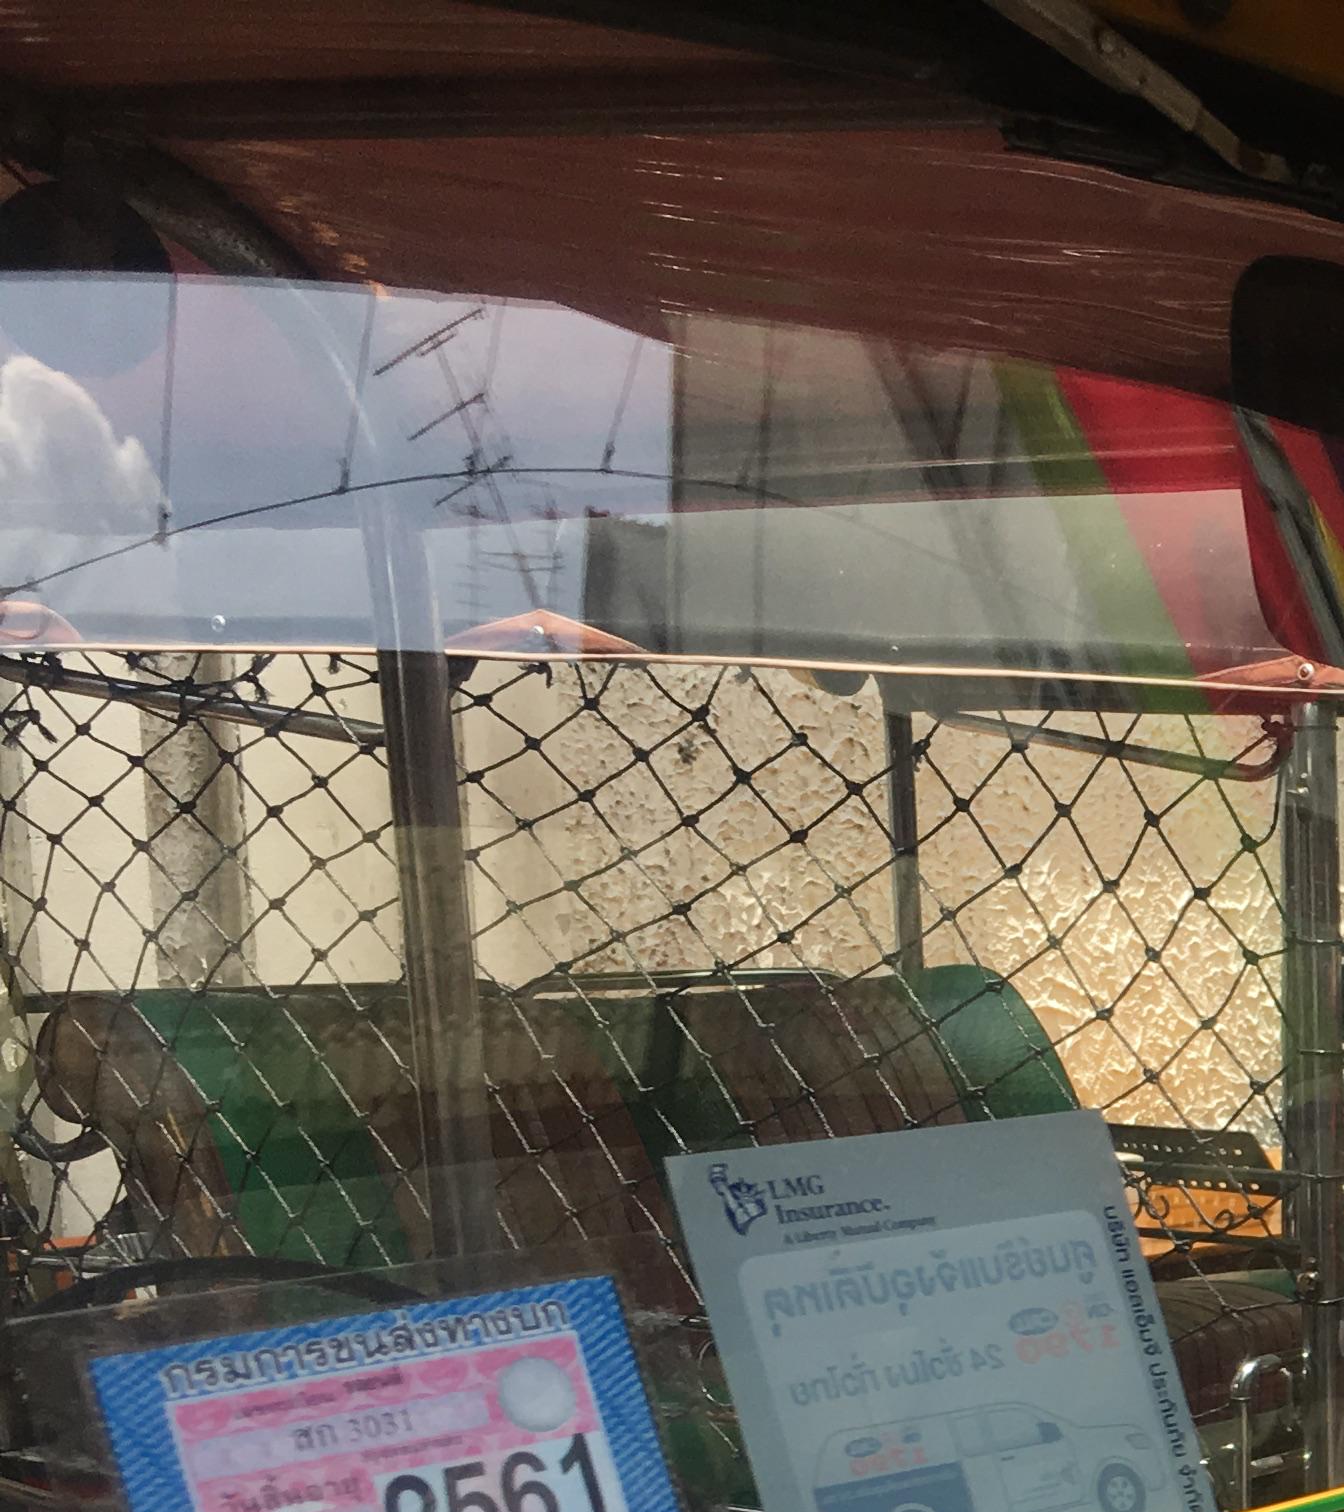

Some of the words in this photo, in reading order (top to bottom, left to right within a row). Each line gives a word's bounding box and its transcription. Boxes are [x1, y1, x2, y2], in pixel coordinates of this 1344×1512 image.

[767, 1174, 825, 1201] LMG
[774, 1197, 892, 1226] Insurance.
[163, 1301, 568, 1395] กรมการขนส่งทางบก
[349, 1408, 415, 1443] 3031
